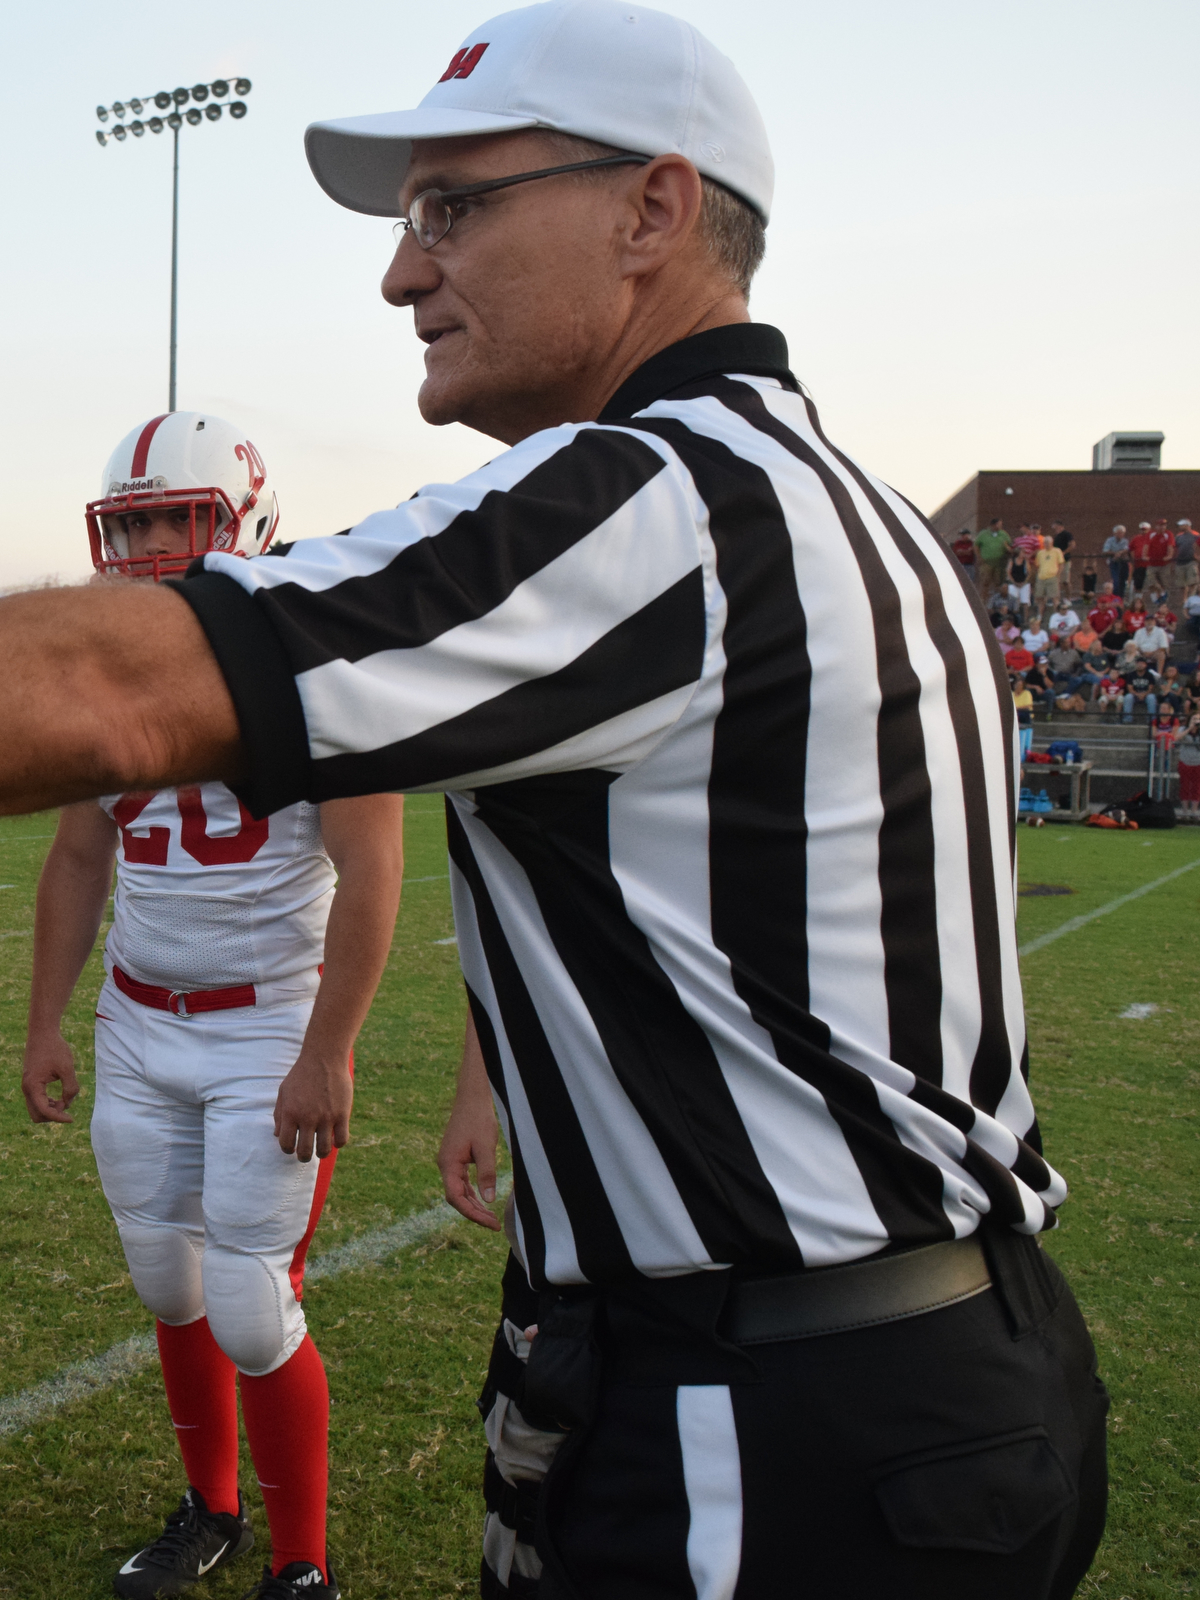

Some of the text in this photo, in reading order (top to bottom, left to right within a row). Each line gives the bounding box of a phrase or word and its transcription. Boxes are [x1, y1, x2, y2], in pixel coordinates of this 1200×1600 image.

[121, 479, 154, 493] Riddell
[234, 439, 267, 488] 20
[112, 782, 270, 867] 20
